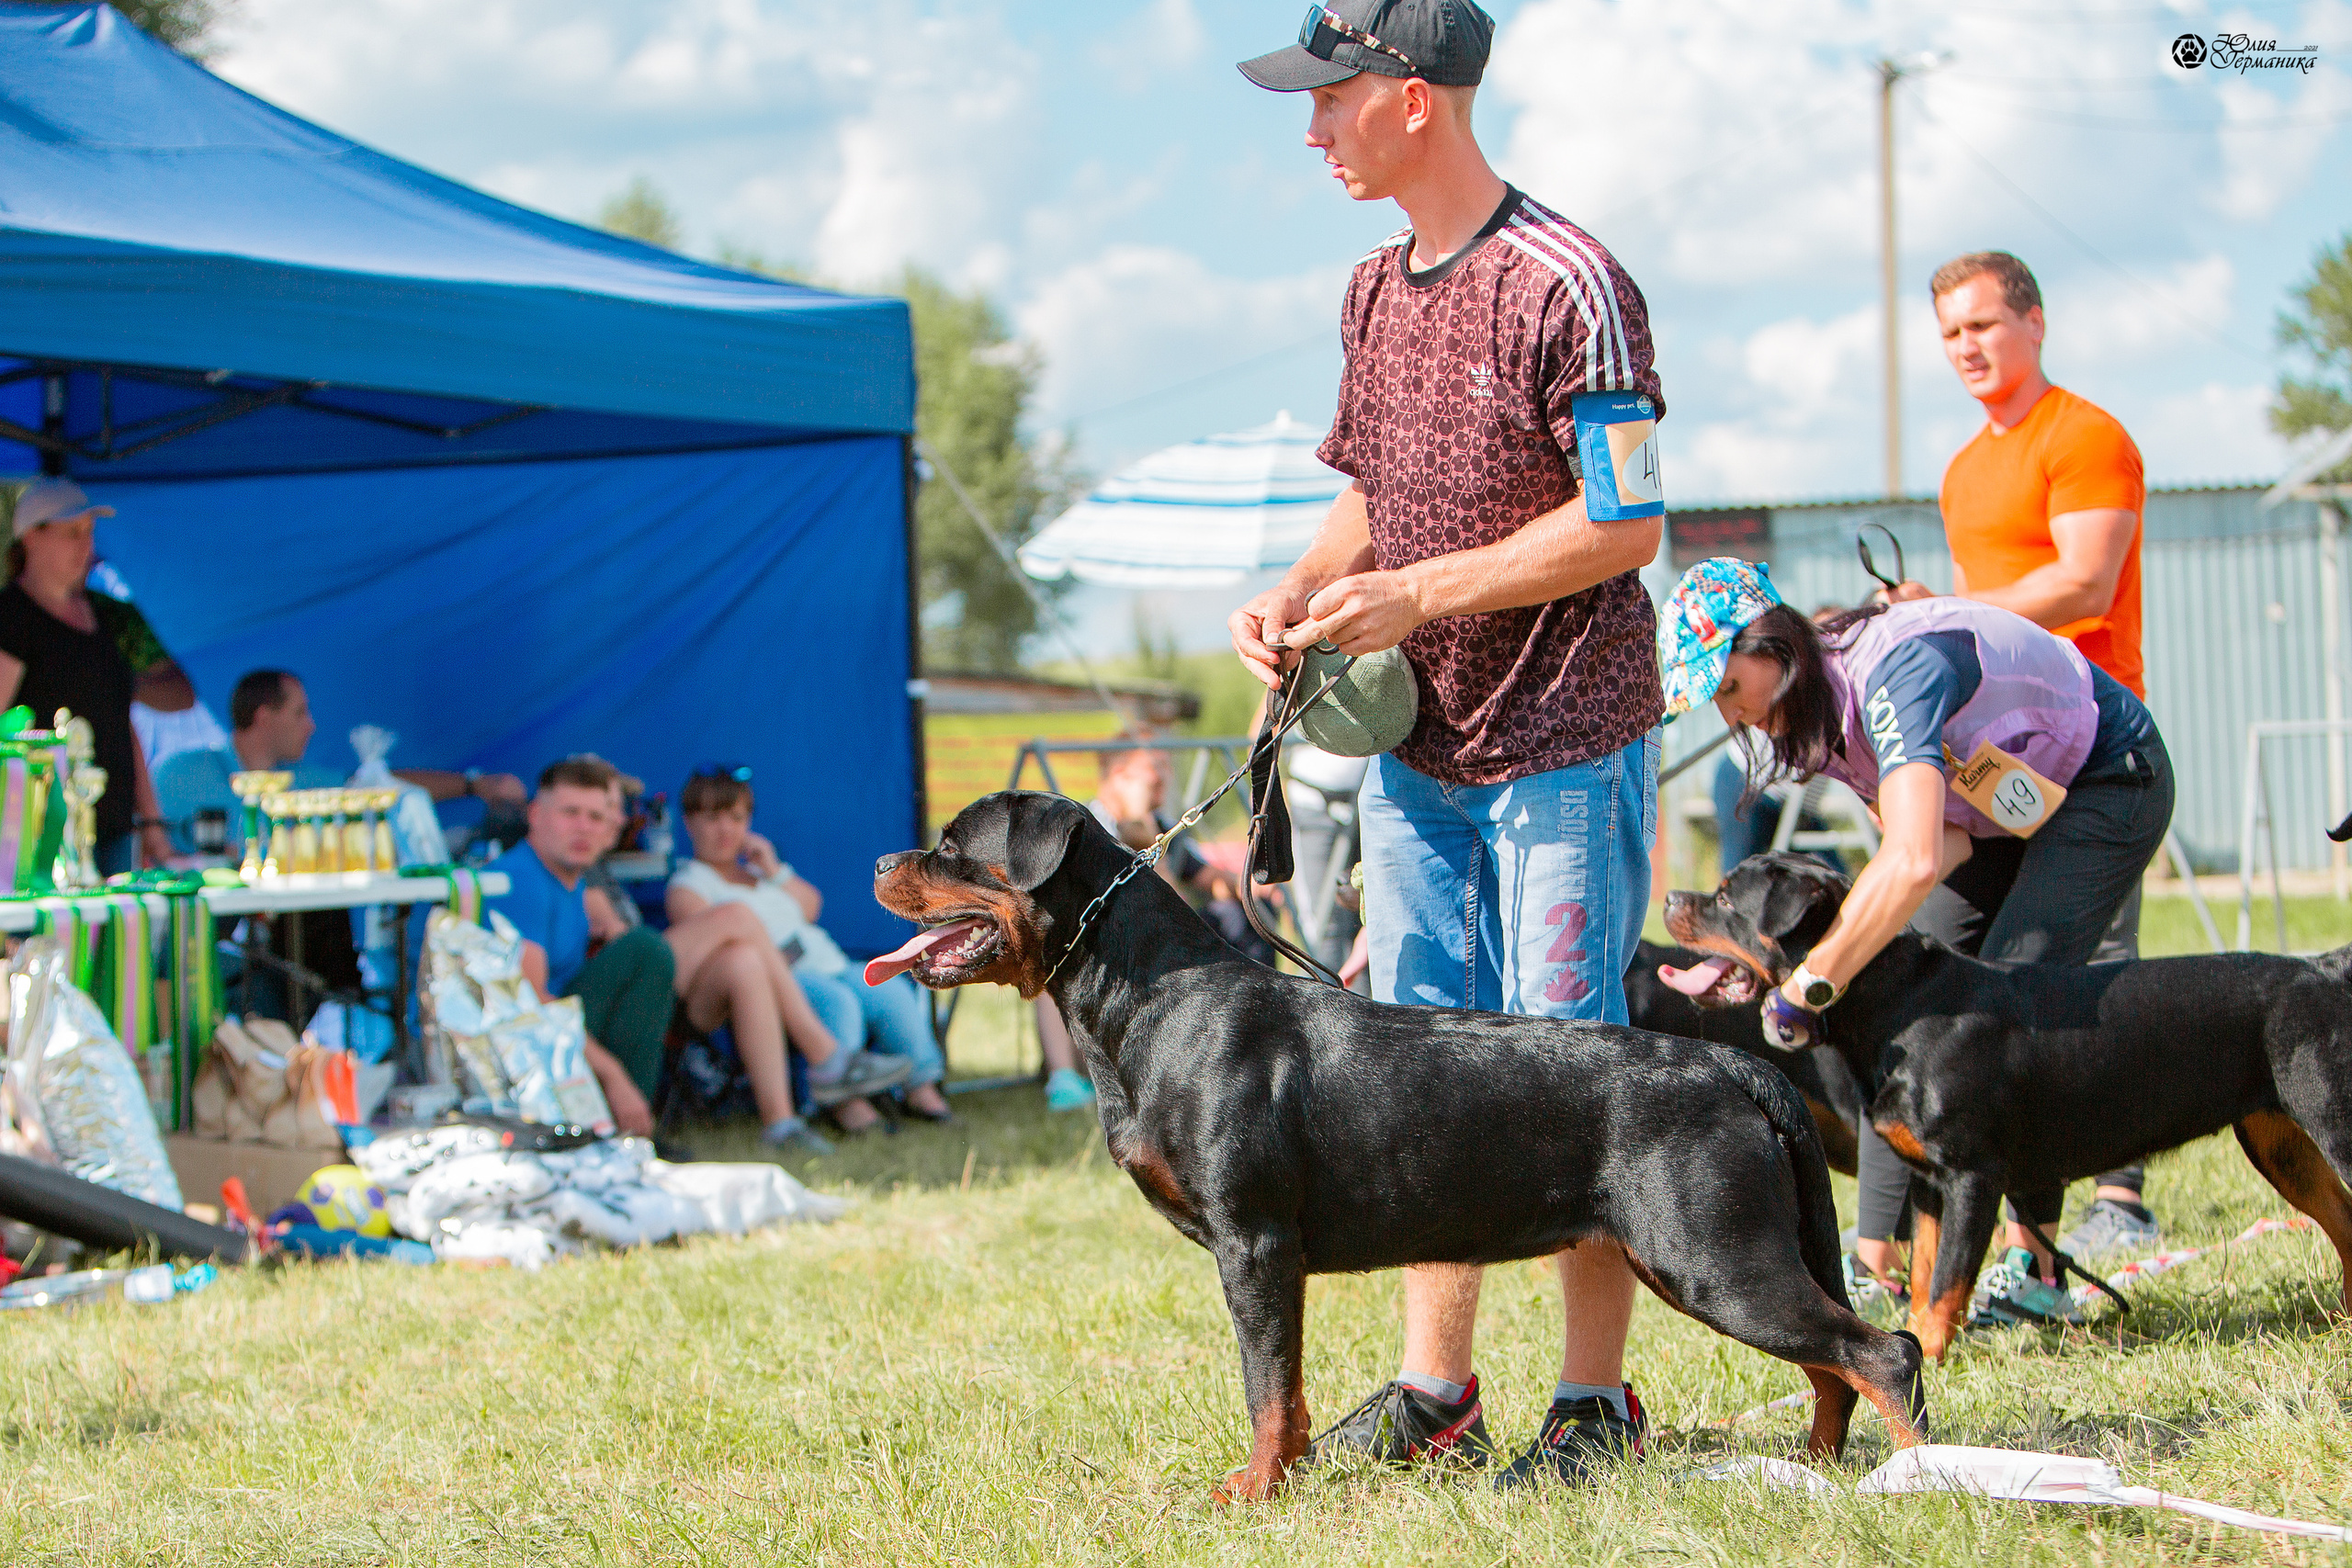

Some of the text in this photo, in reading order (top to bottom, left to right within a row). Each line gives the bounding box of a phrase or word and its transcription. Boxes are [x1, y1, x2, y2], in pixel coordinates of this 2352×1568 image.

[1866, 684, 1908, 767] ROXY
[1995, 777, 2036, 817] 49
[1544, 902, 1588, 963] 2
